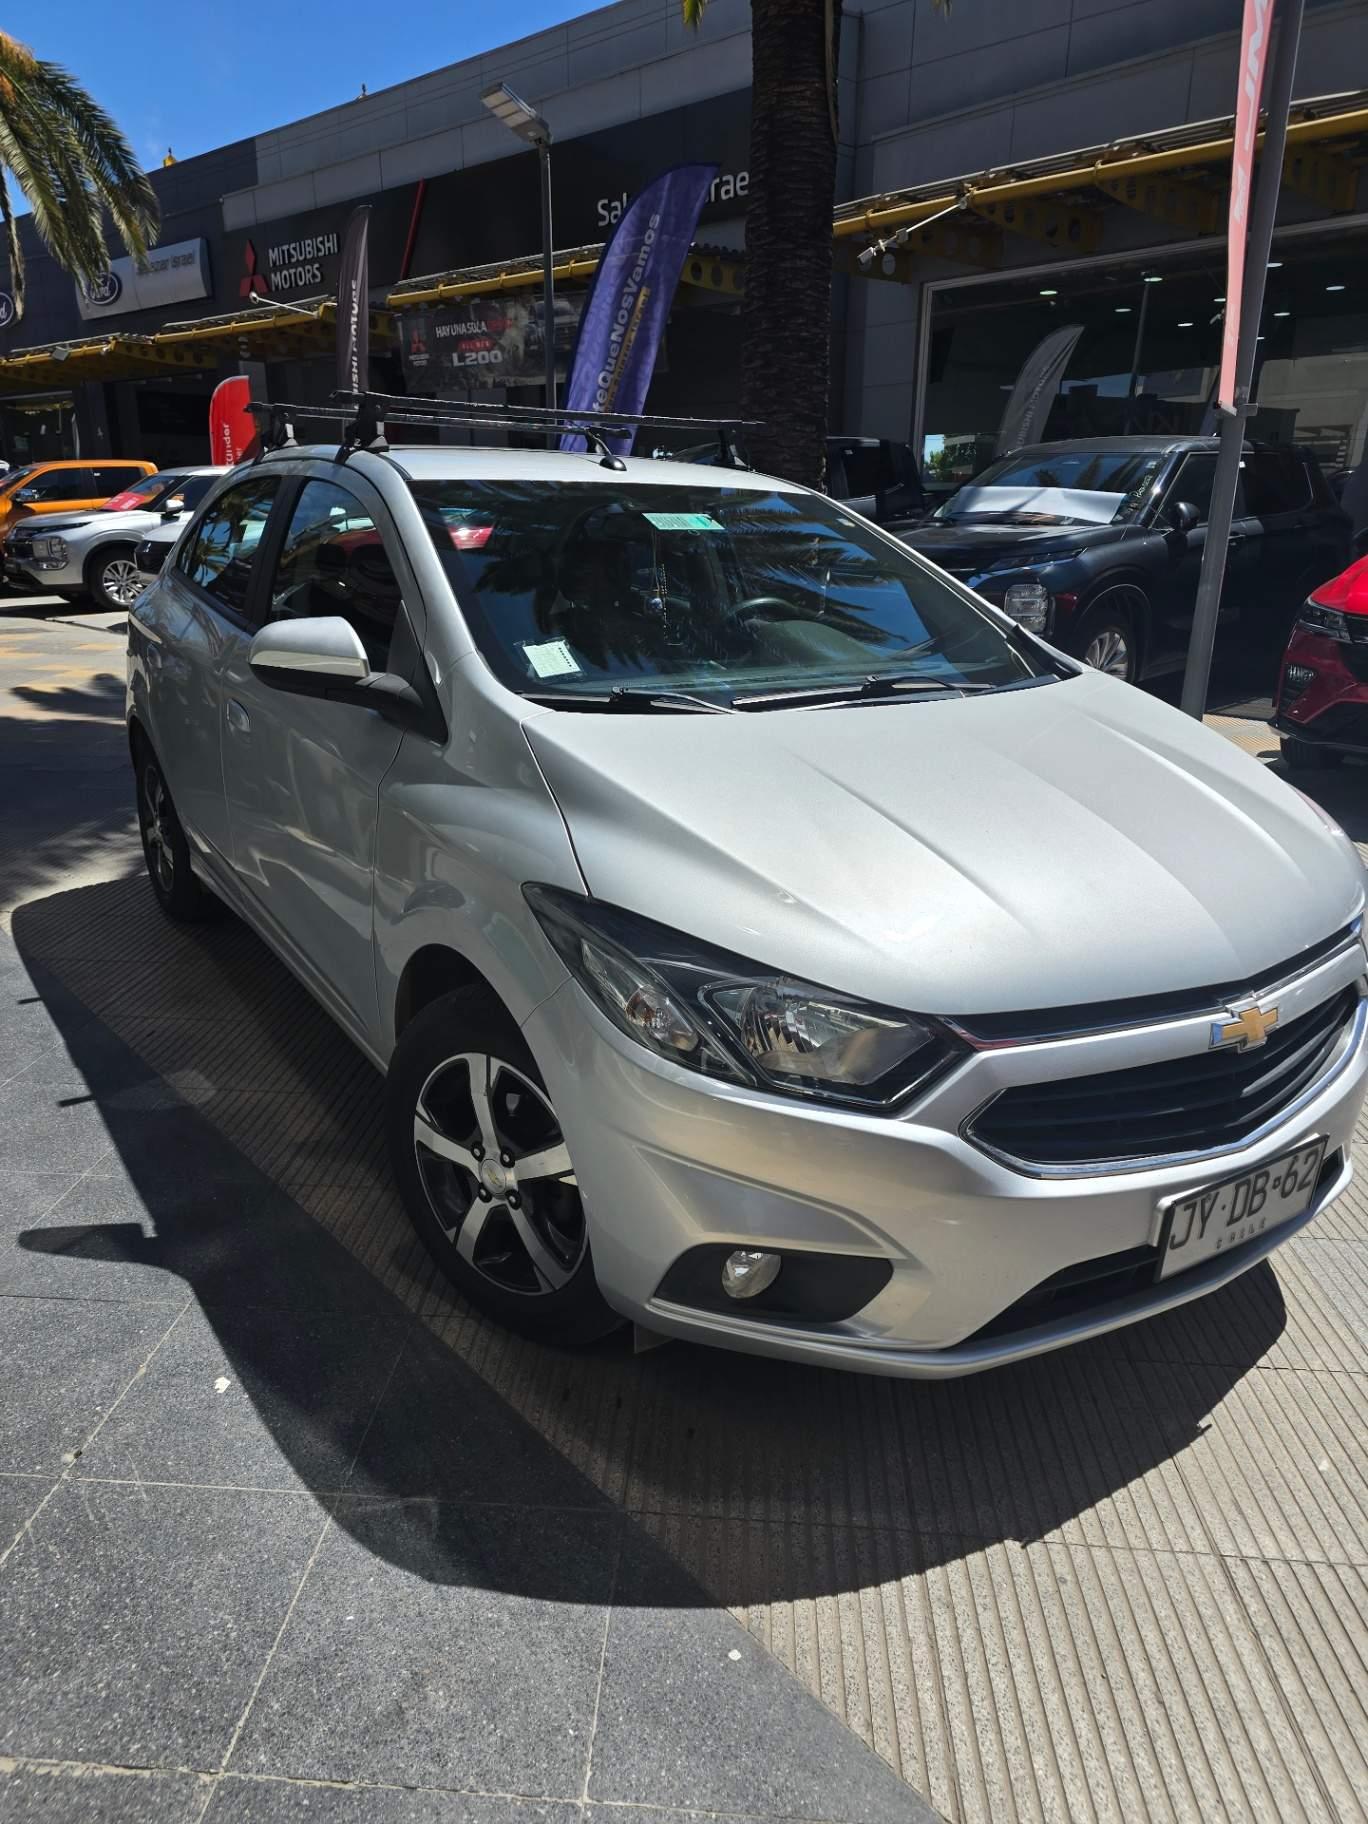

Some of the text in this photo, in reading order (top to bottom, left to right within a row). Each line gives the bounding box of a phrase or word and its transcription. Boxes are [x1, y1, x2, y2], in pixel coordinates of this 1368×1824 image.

[268, 233, 338, 267] MITSUBISHI
[271, 263, 321, 292] MOTORS
[452, 350, 503, 367] L200
